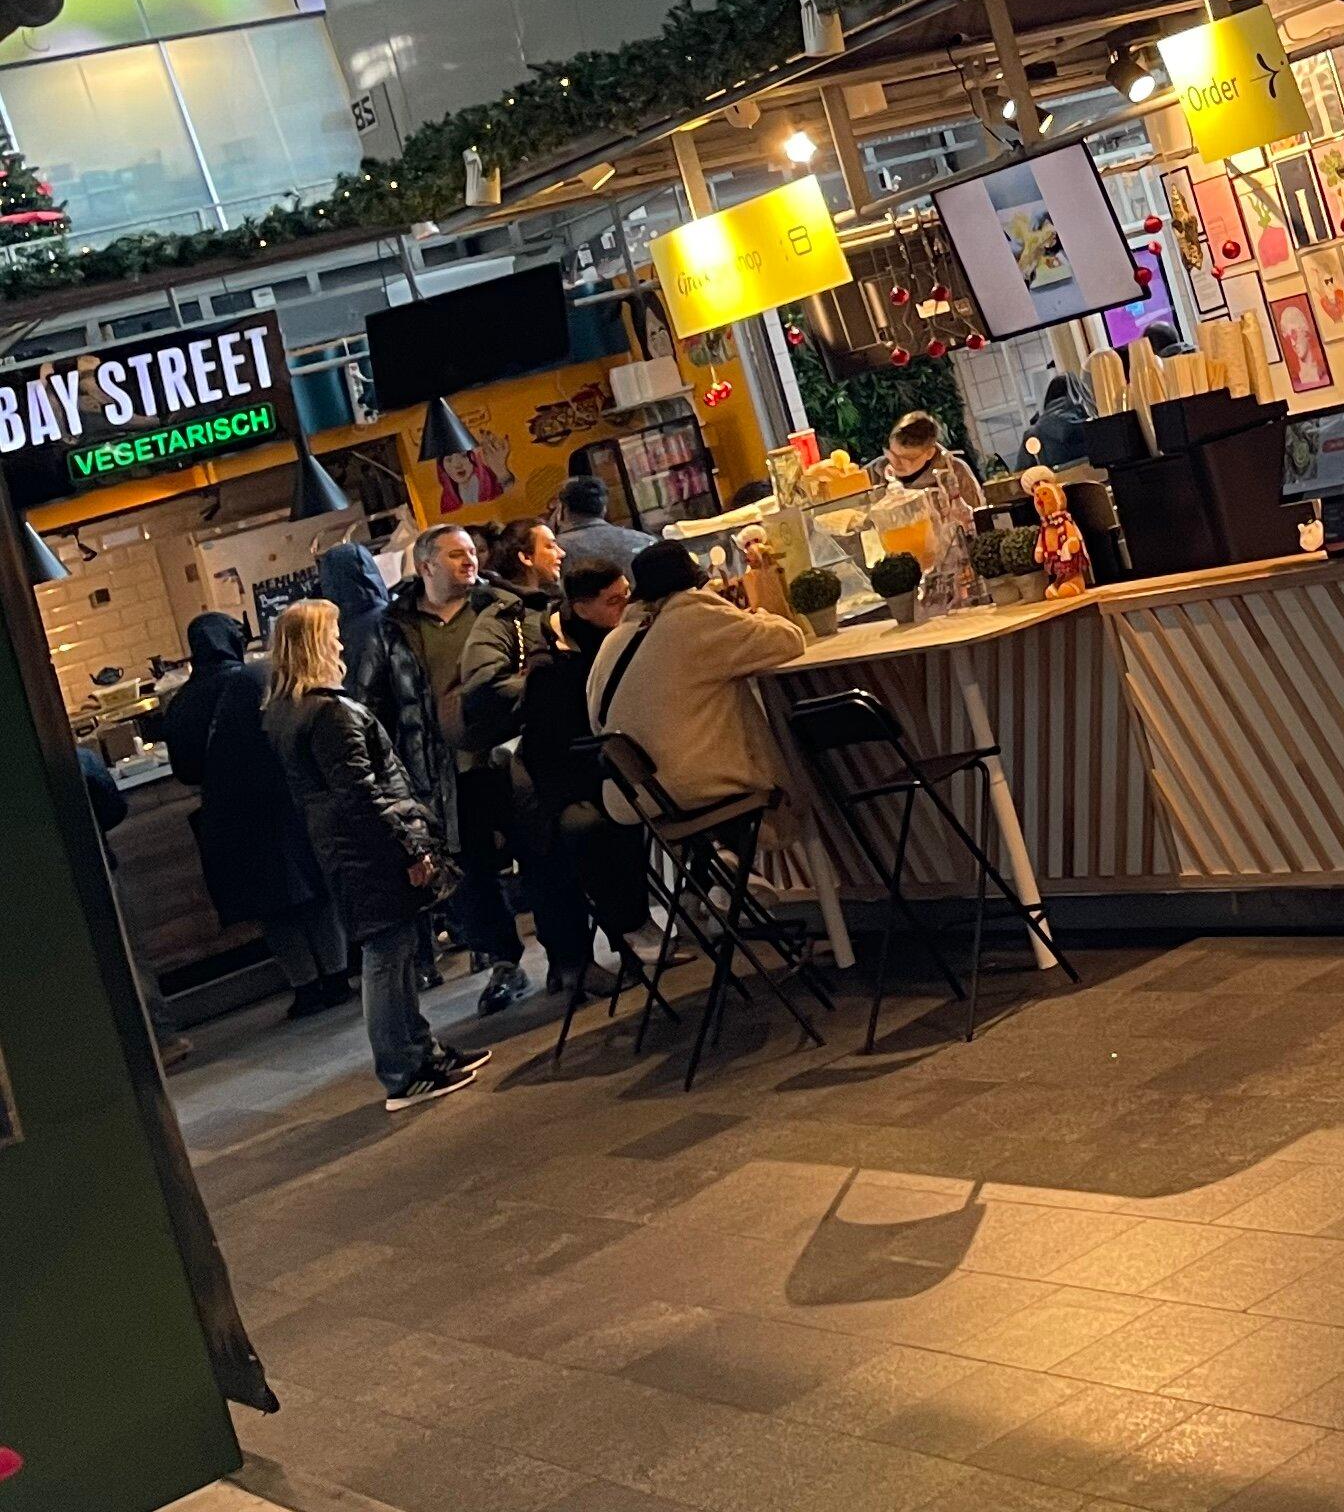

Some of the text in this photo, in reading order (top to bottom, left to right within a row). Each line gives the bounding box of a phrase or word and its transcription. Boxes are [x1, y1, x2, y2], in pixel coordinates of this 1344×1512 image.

[351, 96, 376, 132] 85
[1187, 76, 1240, 112] Order
[0, 325, 273, 454] BAY STREET
[73, 407, 271, 476] VEGETARISCH
